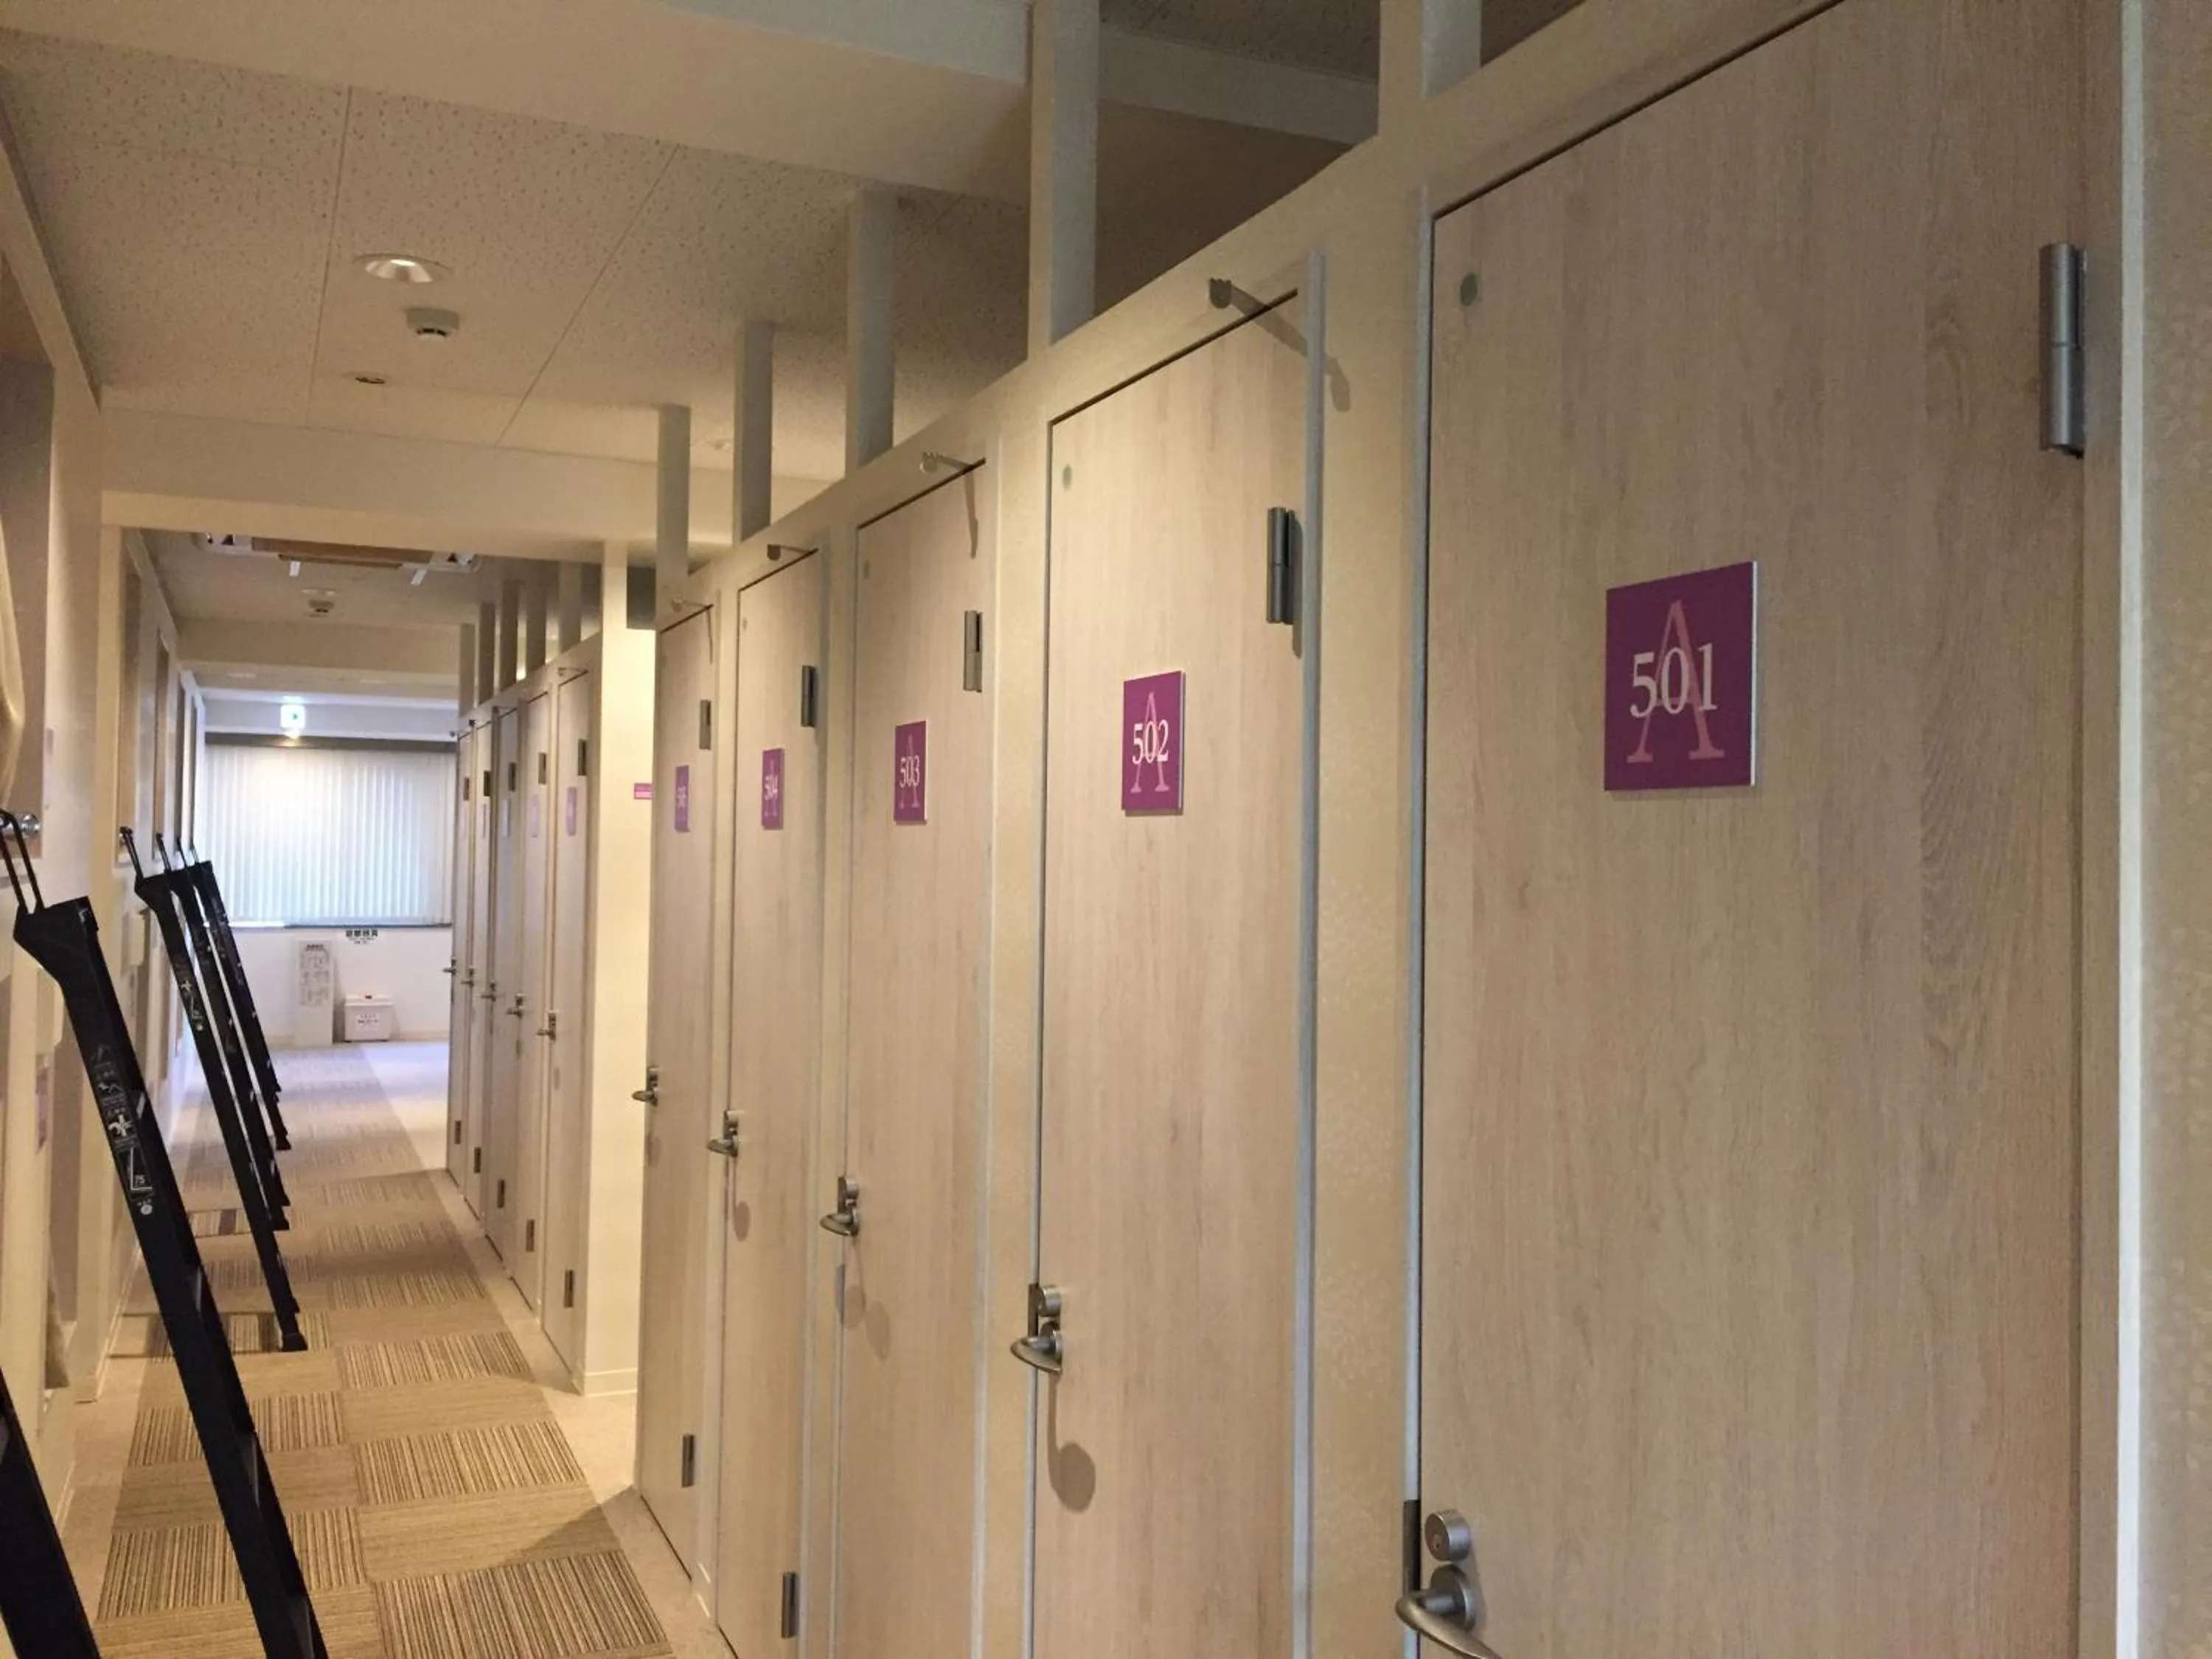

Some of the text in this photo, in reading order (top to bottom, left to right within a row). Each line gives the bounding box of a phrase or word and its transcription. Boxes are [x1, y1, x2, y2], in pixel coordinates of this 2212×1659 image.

[1627, 599, 1725, 763] A
[1630, 643, 1717, 718] 501
[900, 754, 920, 788] 503
[1130, 692, 1169, 793] A
[1132, 719, 1169, 765] 502
